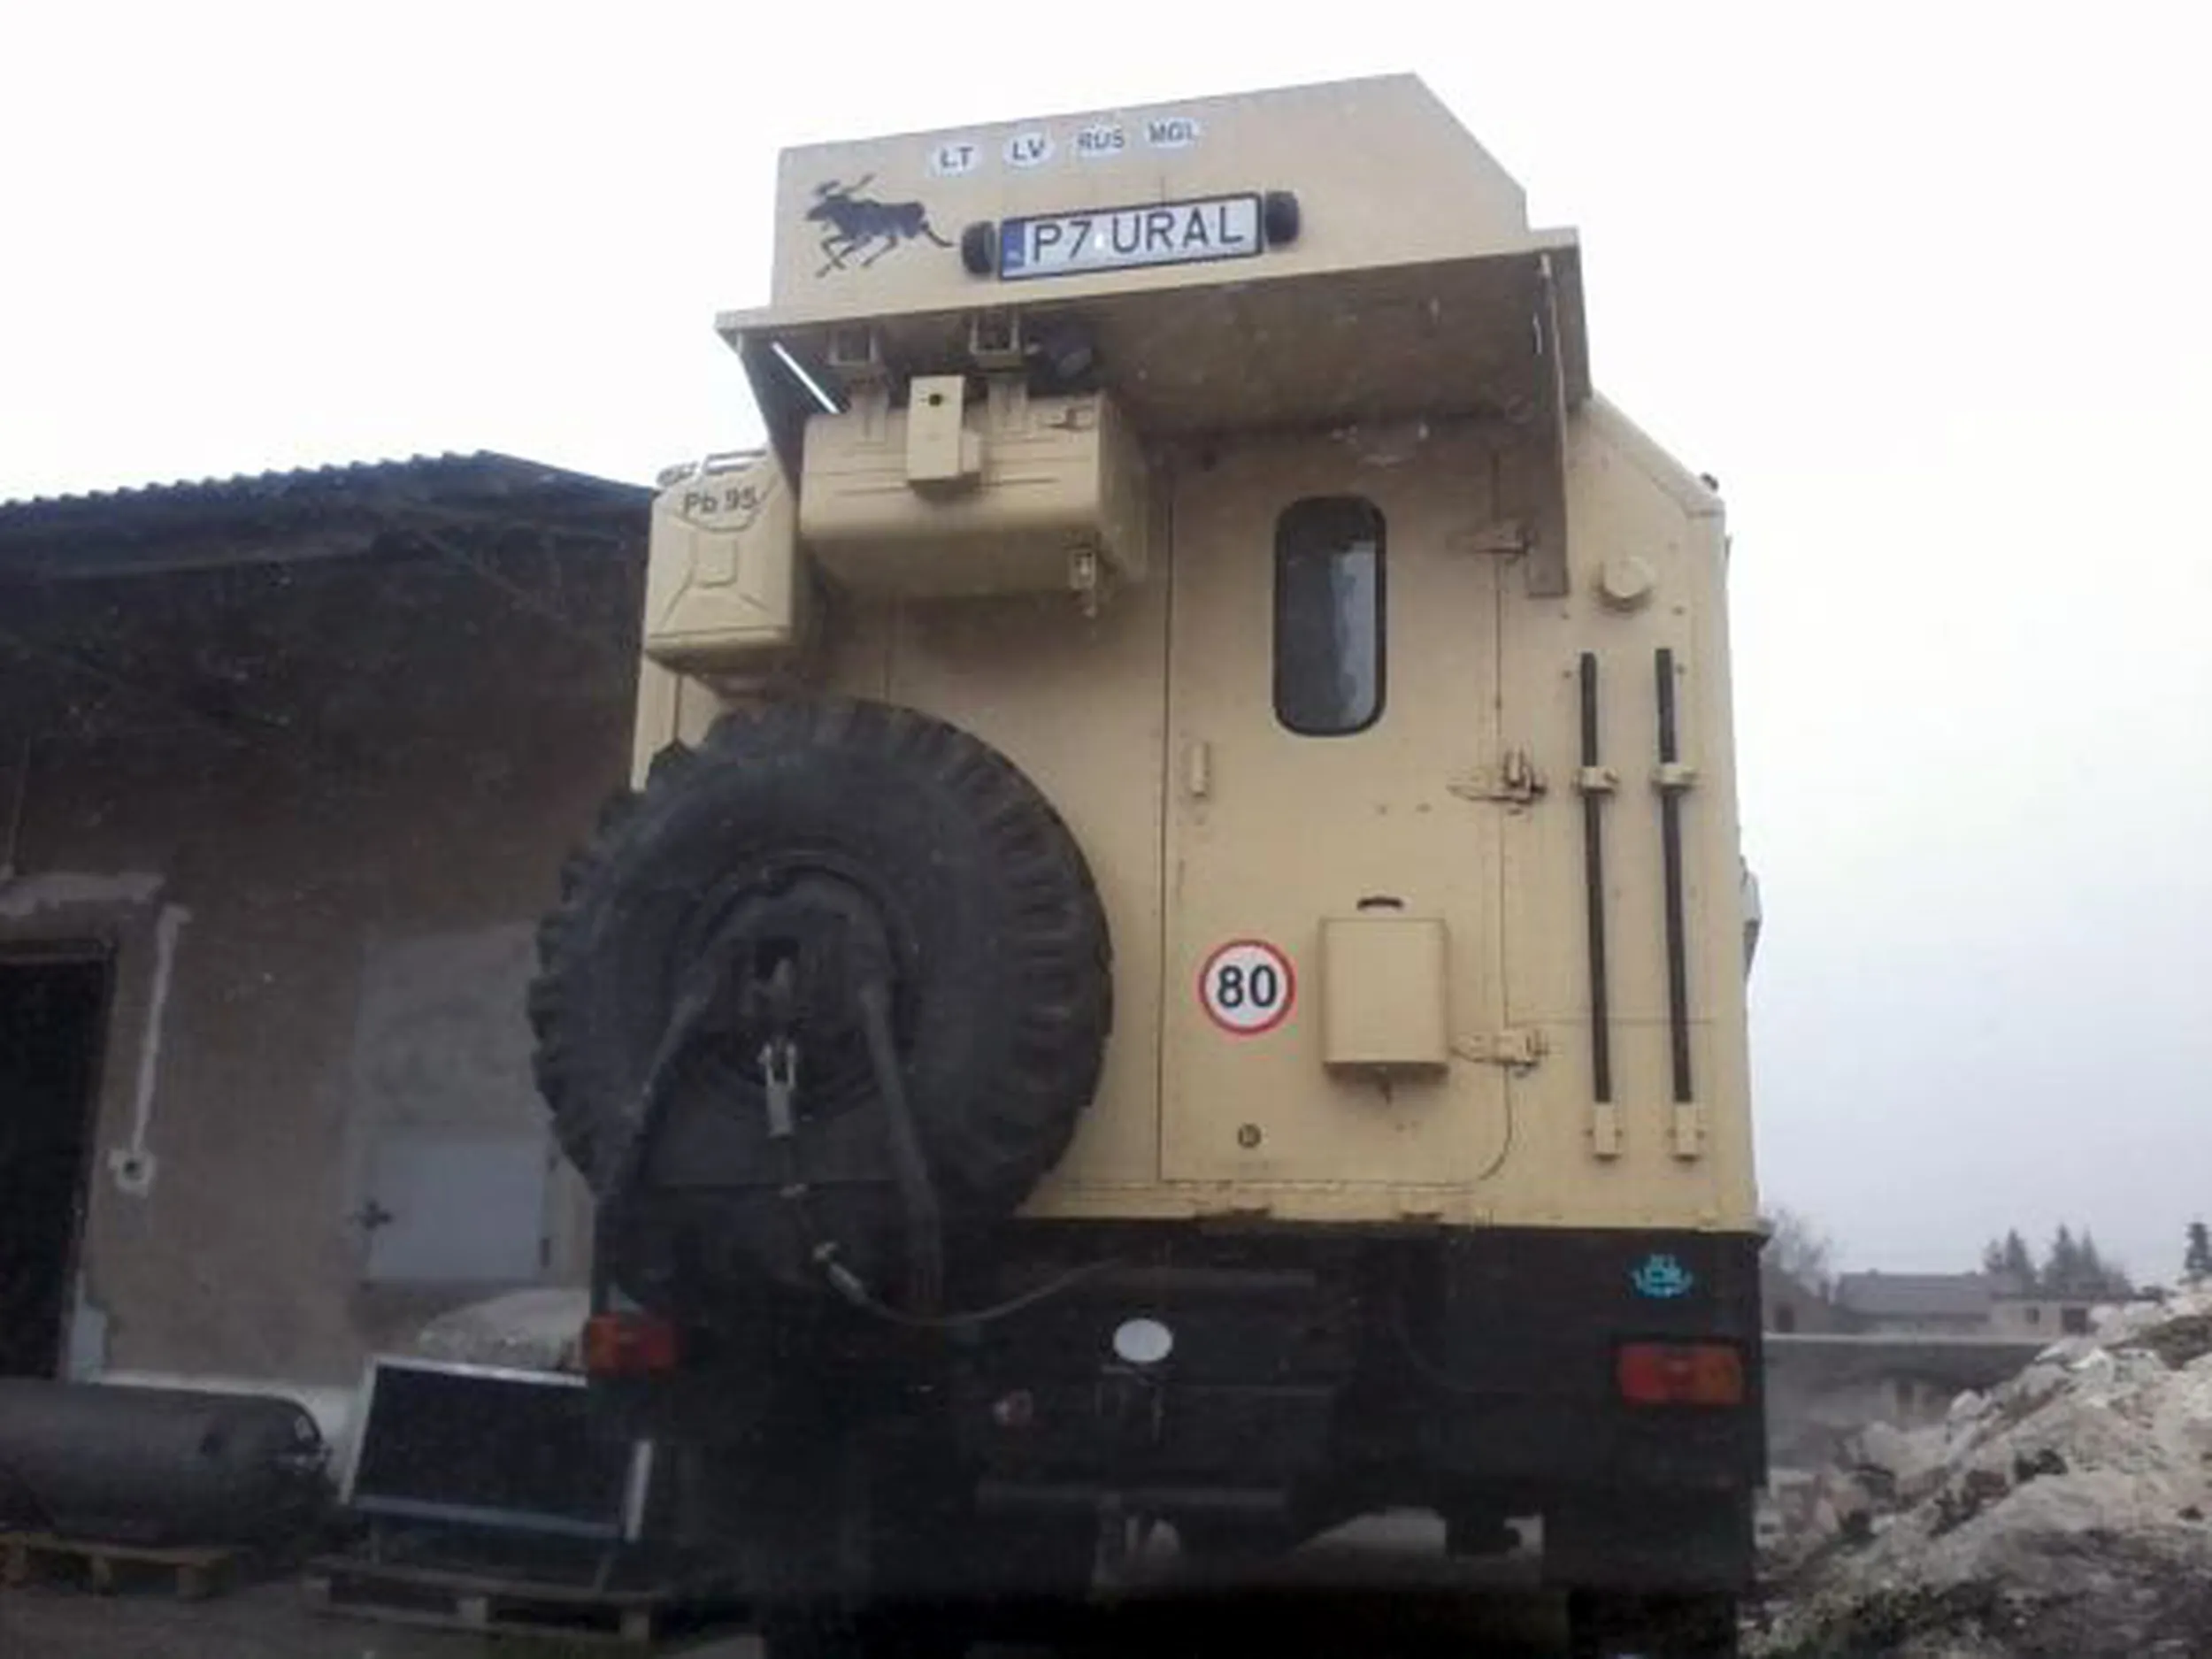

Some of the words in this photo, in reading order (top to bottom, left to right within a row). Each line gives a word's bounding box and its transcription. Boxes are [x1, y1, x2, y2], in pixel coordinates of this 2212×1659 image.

[939, 146, 973, 168] LT
[1011, 137, 1045, 160] LV
[1033, 220, 1093, 263] P7
[1111, 205, 1244, 253] URAL
[683, 487, 718, 515] Pb
[1217, 964, 1277, 1008] 80
